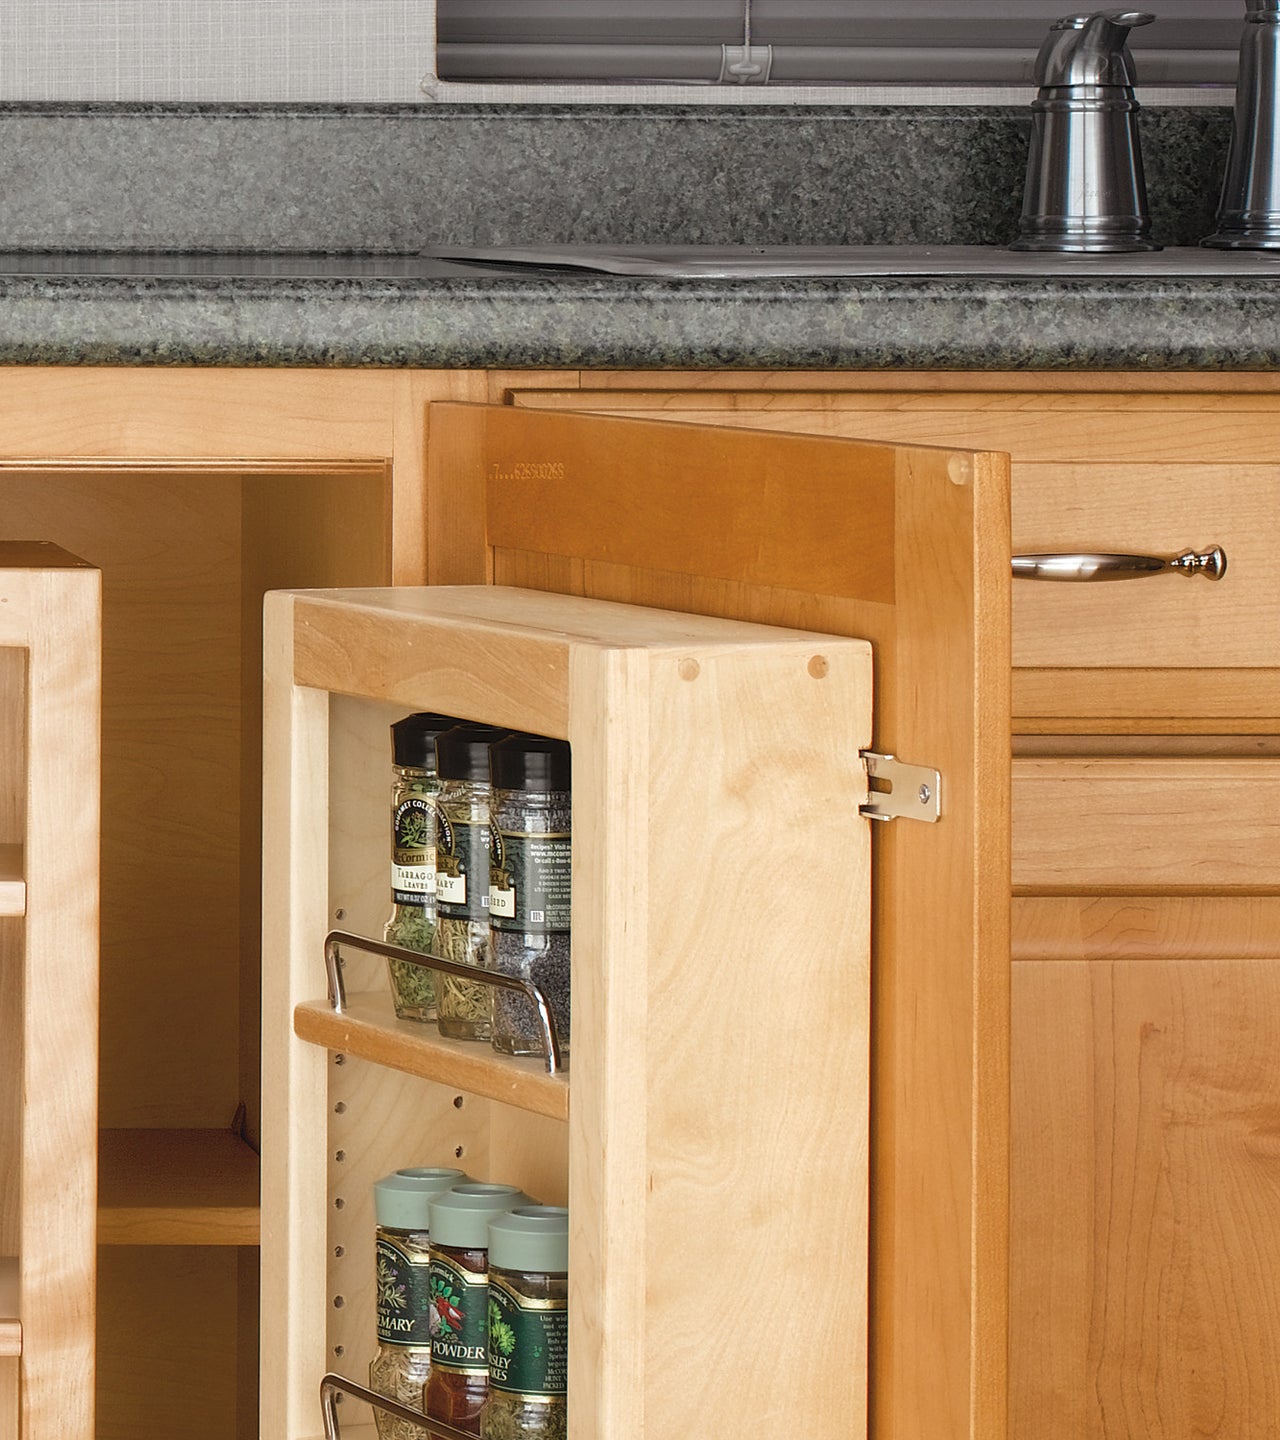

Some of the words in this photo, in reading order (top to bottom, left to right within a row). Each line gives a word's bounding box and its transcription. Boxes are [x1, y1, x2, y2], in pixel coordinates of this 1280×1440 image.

[397, 867, 435, 880] TARRAGO
[403, 880, 429, 889] LEAVES
[433, 1341, 485, 1360] POWDER
